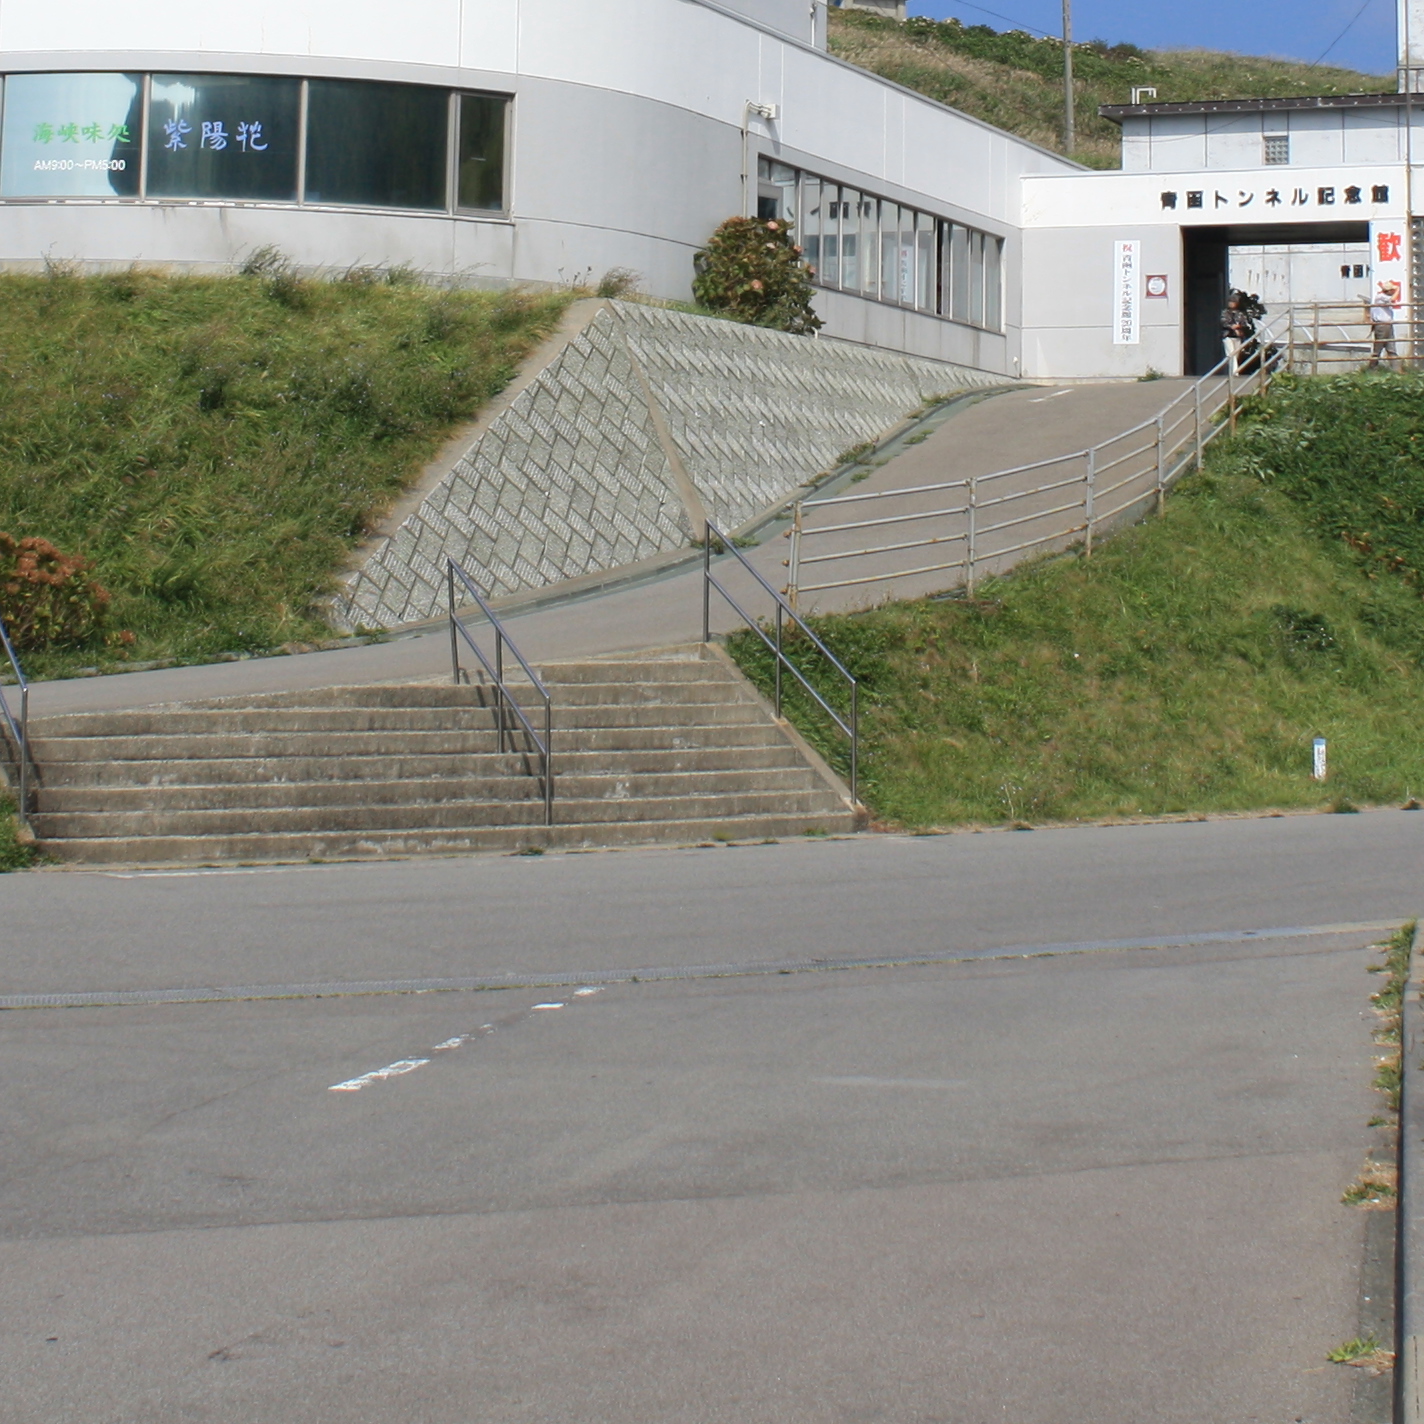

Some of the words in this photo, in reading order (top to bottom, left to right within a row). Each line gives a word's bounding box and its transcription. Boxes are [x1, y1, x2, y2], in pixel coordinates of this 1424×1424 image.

[33, 122, 131, 144] 海峡味処
[1161, 185, 1389, 210] 青函トンネル記念館
